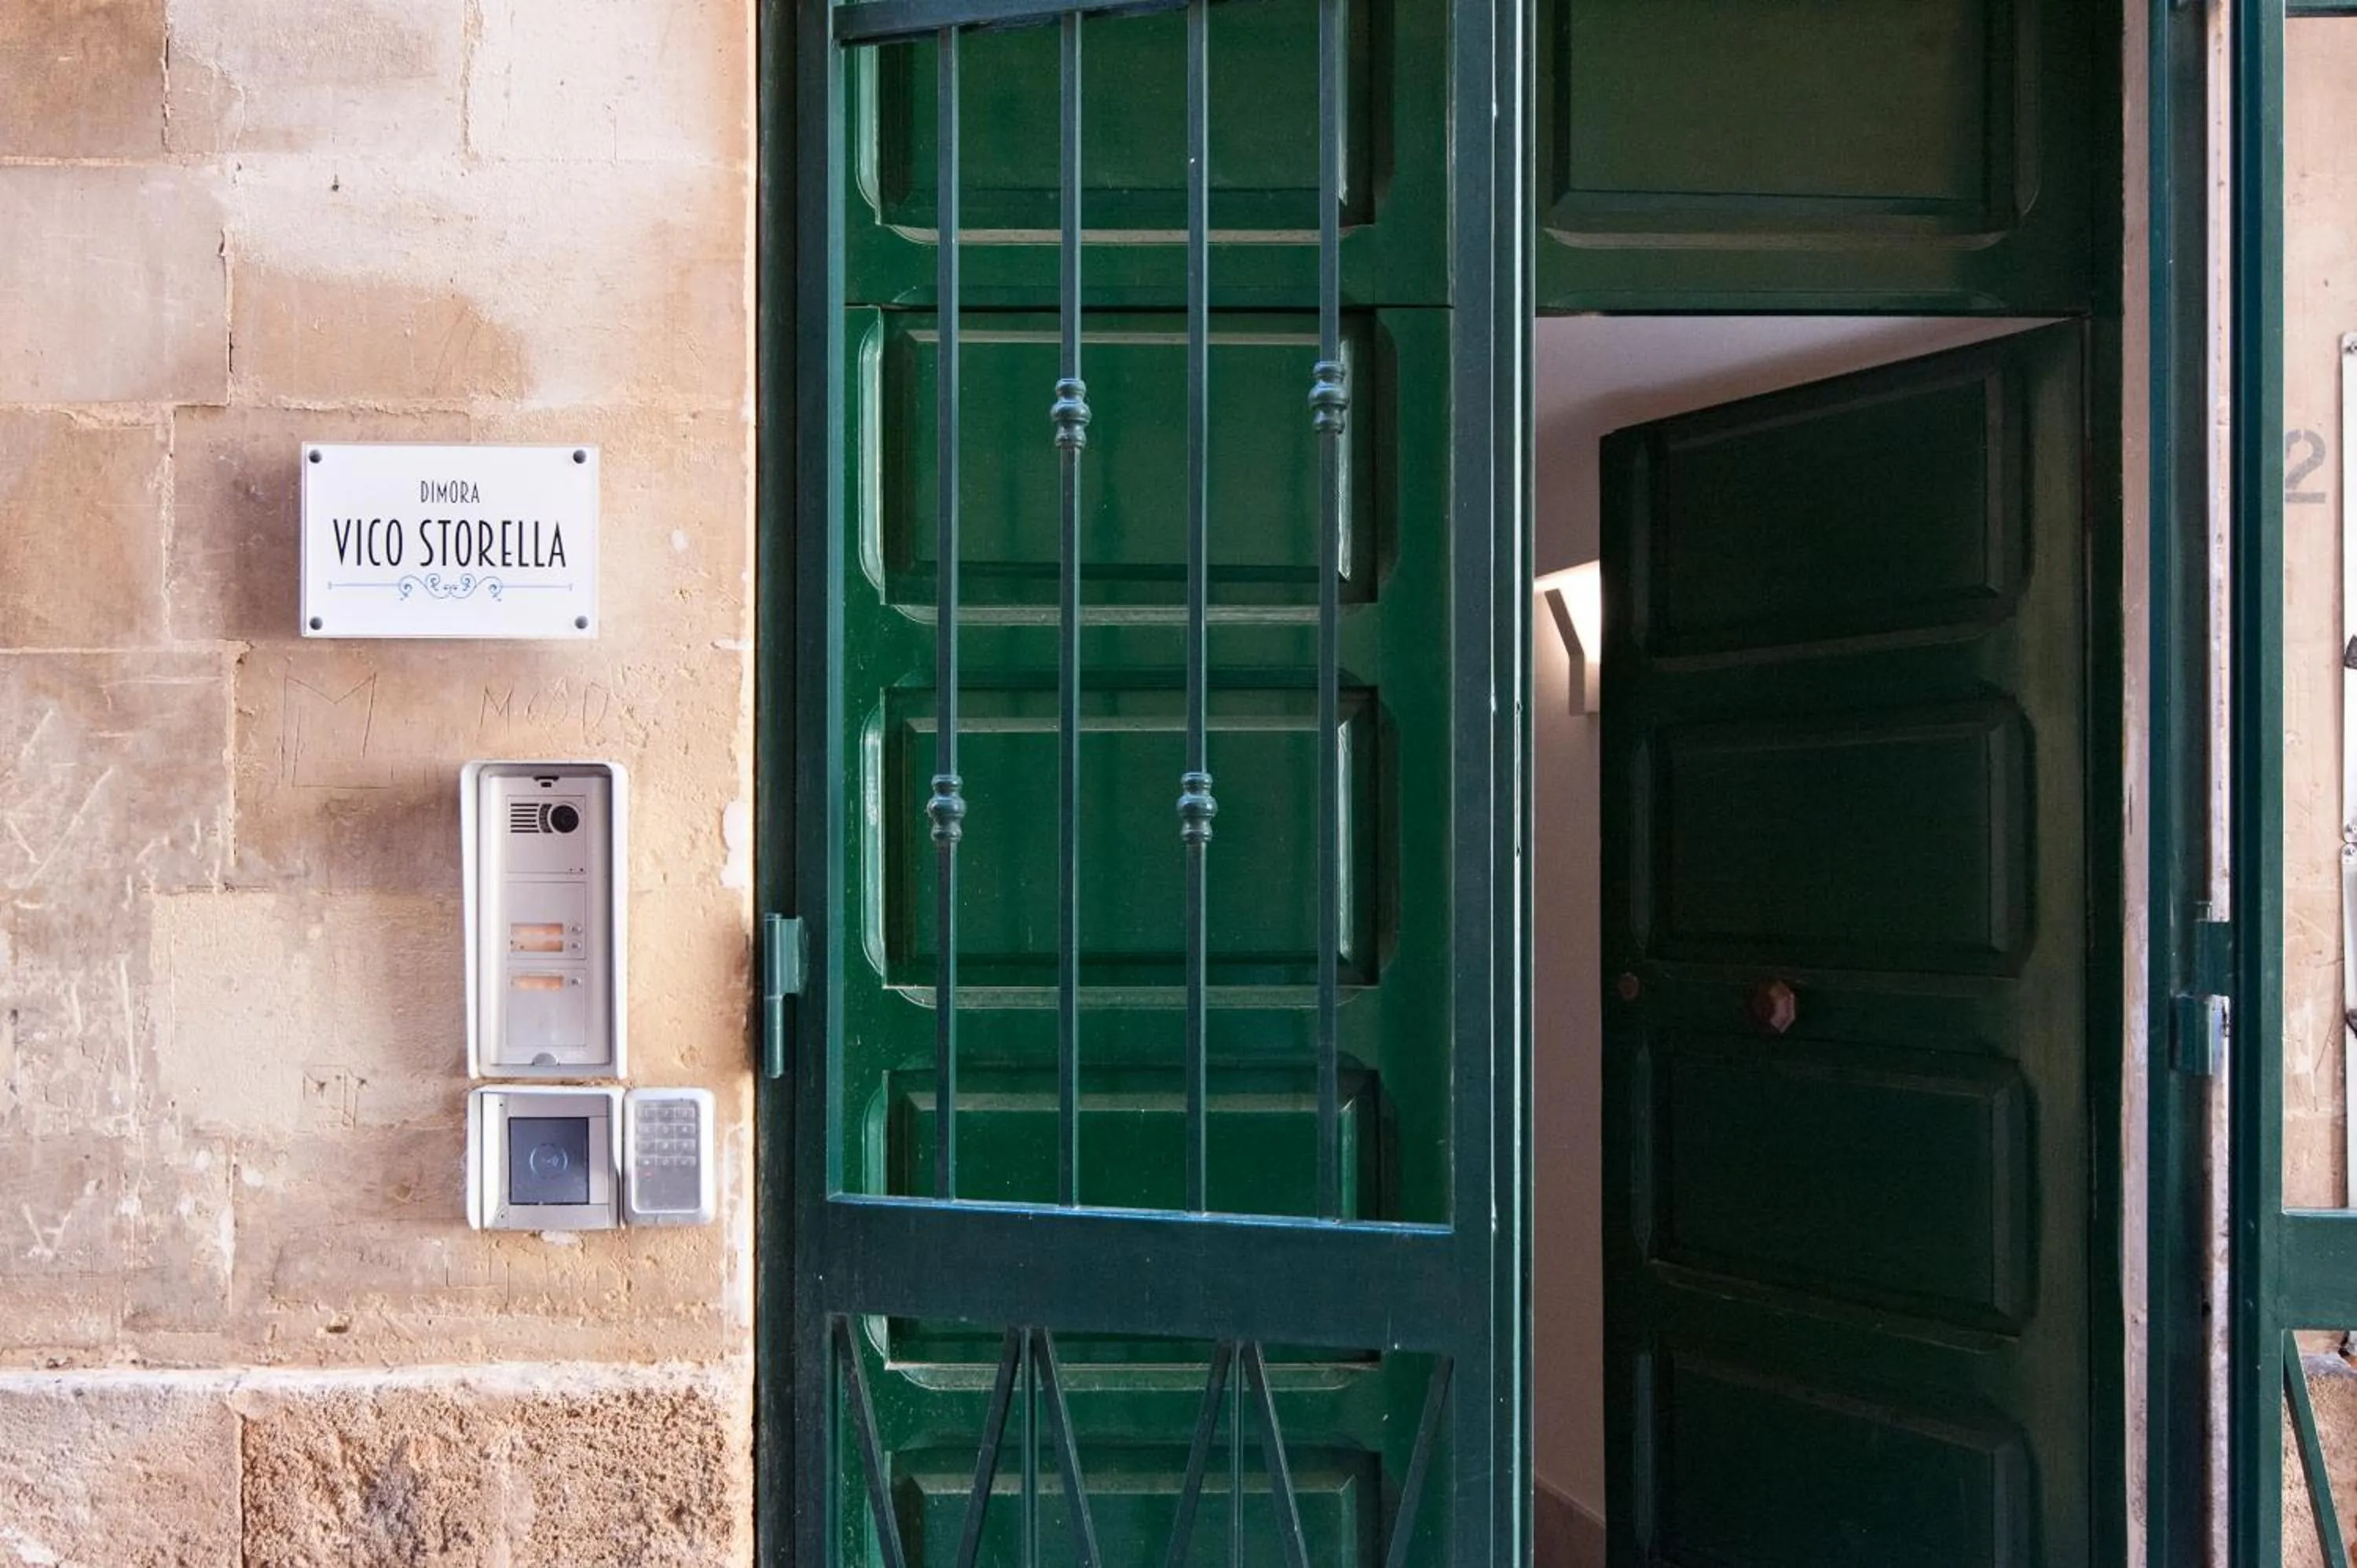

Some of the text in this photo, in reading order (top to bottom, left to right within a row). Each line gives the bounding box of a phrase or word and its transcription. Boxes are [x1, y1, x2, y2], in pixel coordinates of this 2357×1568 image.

[420, 479, 481, 504] DIMORA
[2285, 429, 2326, 504] 2
[332, 518, 566, 568] VICO STORELLA
